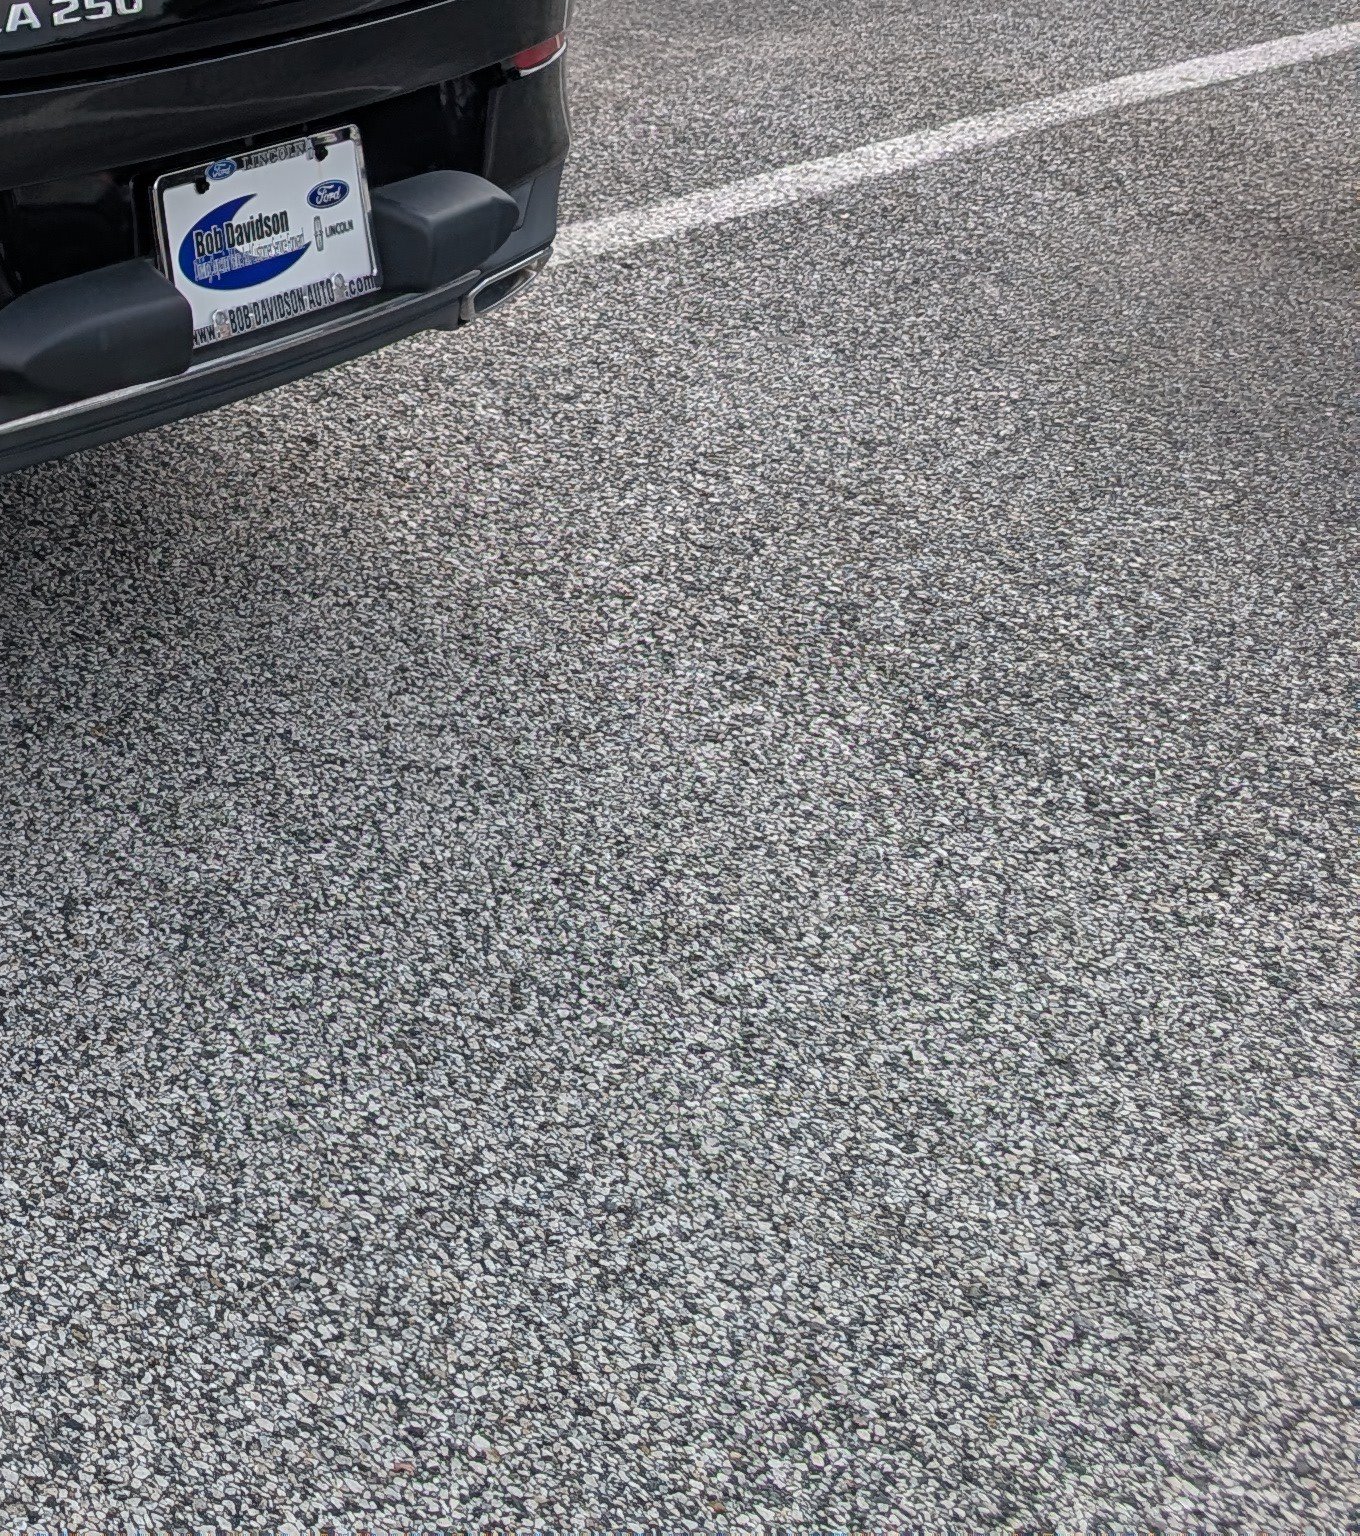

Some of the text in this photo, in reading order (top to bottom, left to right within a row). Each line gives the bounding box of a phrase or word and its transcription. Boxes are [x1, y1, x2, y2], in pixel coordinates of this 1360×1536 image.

[242, 141, 307, 171] LINCOLN
[194, 225, 224, 258] Bob
[224, 210, 290, 248] Davidson
[325, 219, 355, 238] LINCOLN
[229, 306, 253, 334] BOB
[254, 288, 306, 326] DAVIDSON
[308, 278, 335, 306] AUTO
